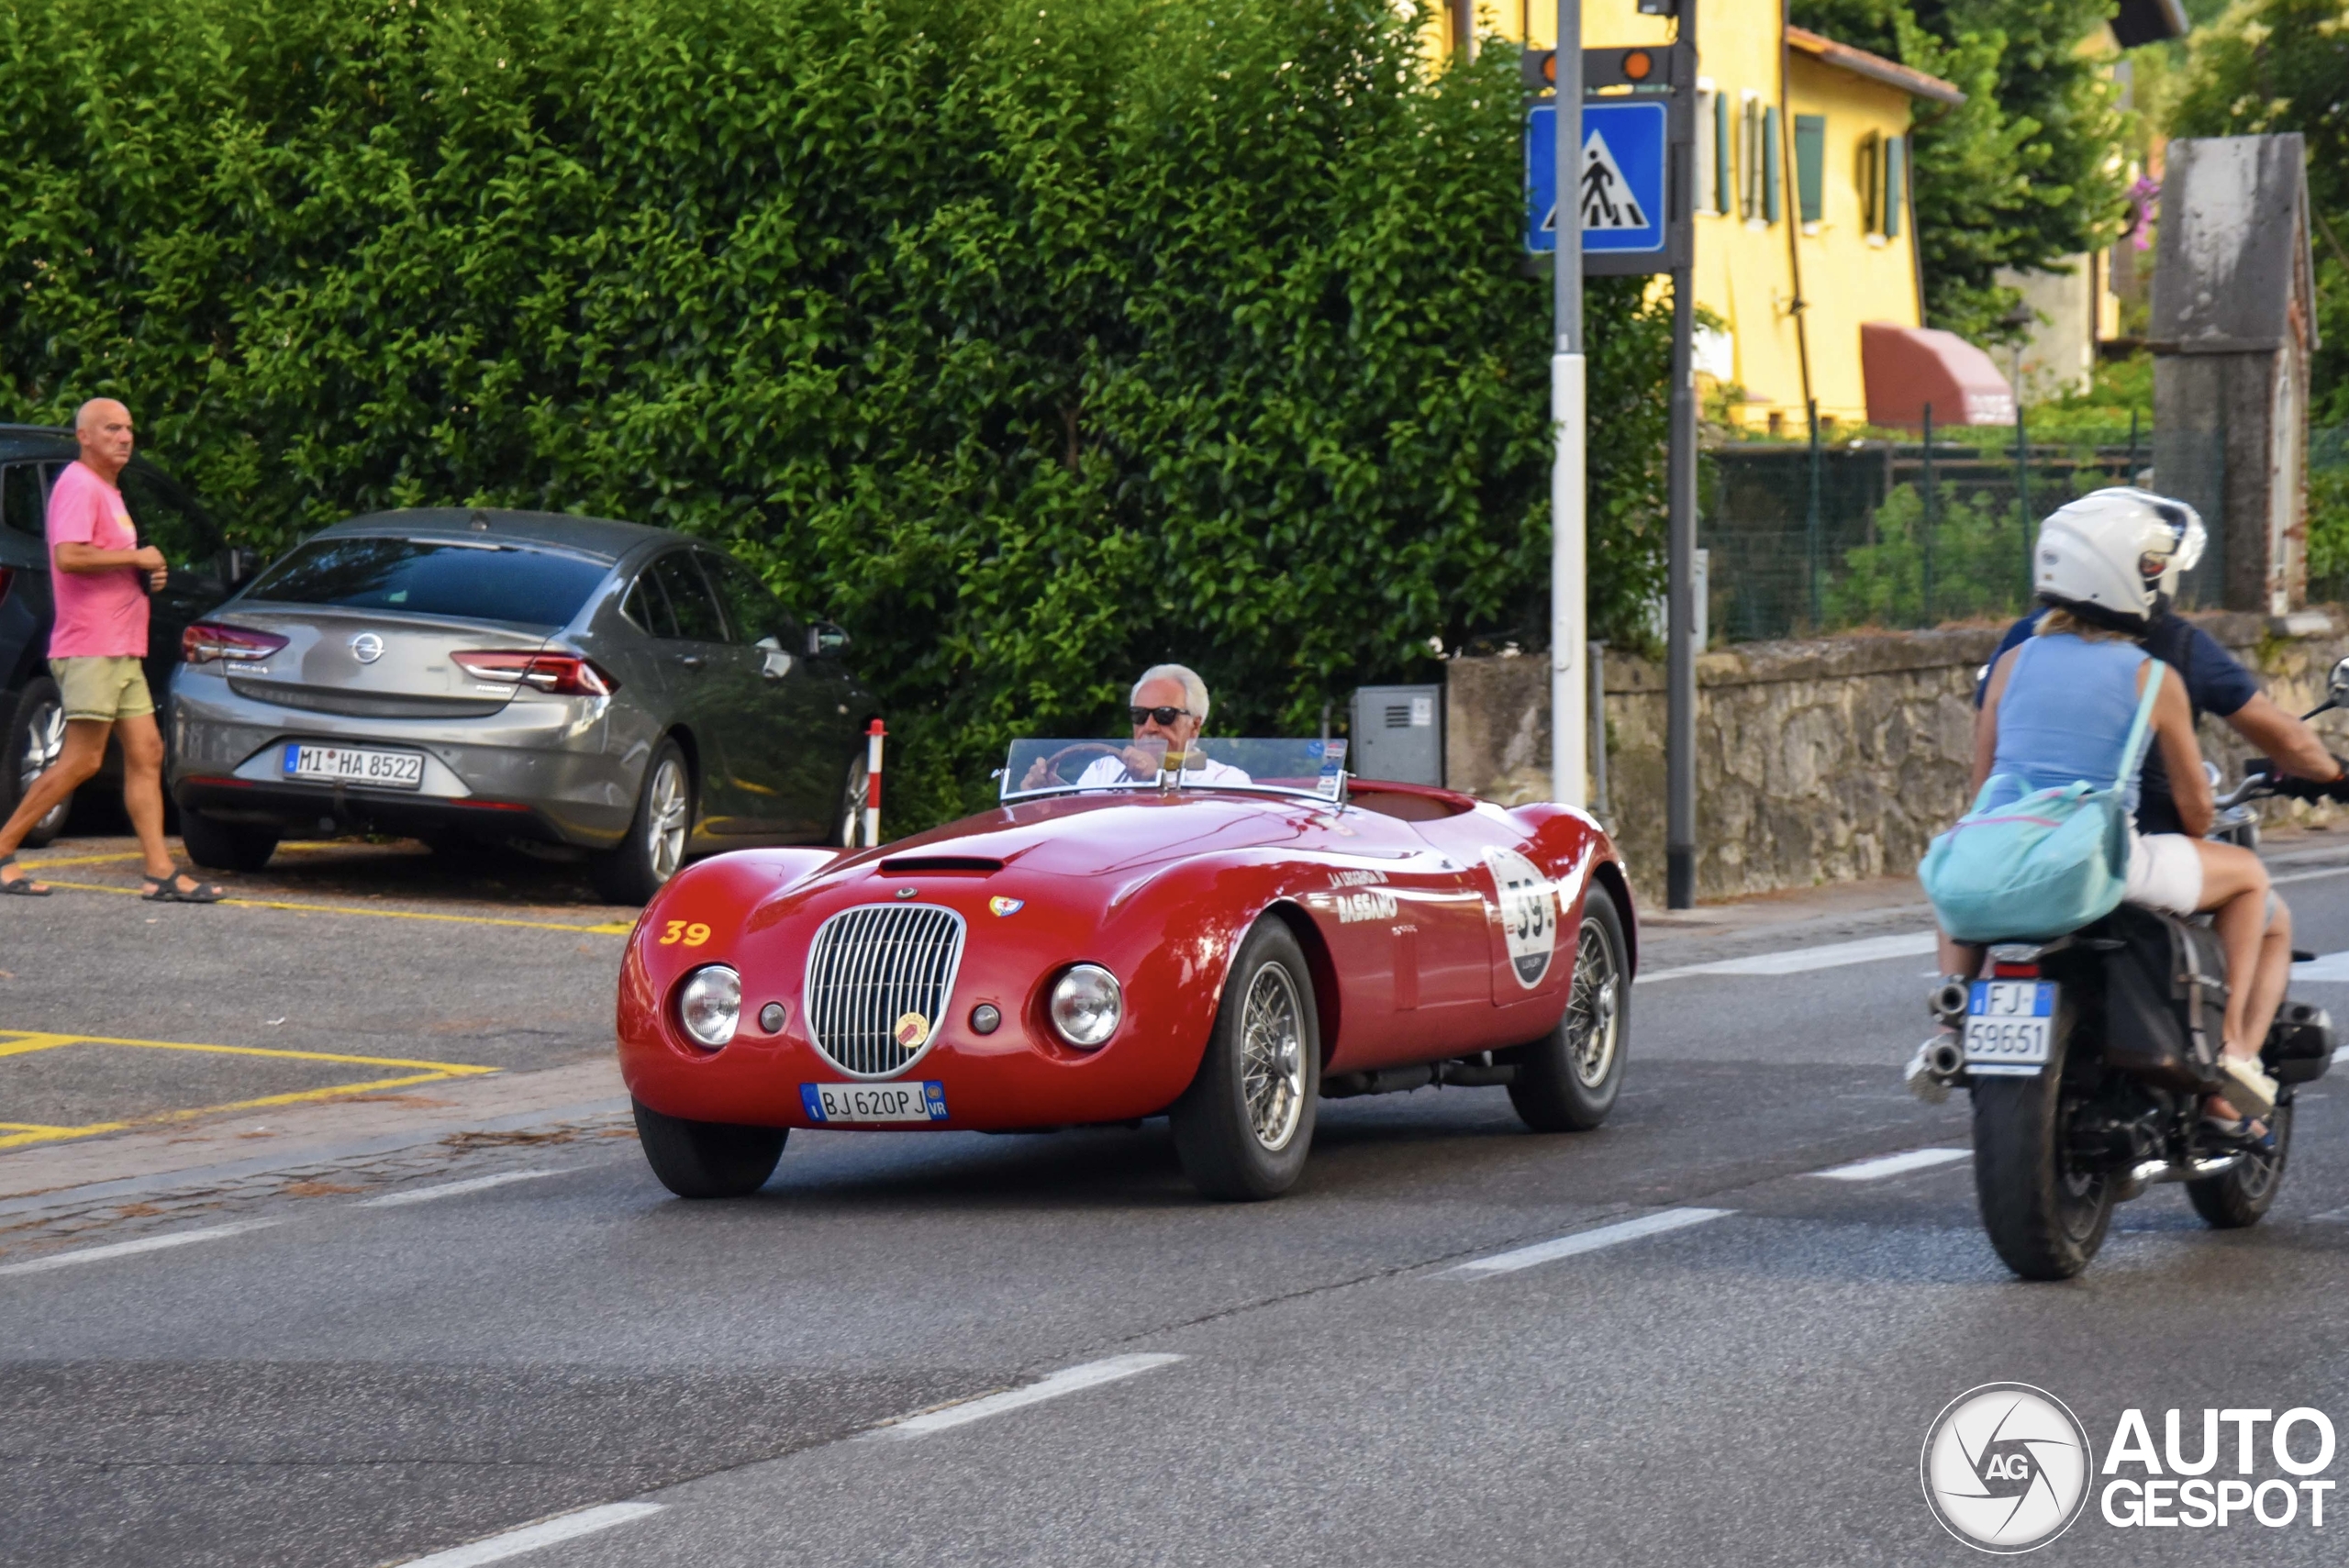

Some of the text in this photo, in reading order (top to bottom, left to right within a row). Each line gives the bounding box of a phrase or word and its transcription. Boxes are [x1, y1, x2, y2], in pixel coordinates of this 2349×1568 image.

[298, 751, 419, 780] MI HA 8522
[659, 919, 712, 947] 39
[1989, 985, 2021, 1014] FJ
[1967, 1023, 2043, 1055] 59651
[929, 1102, 947, 1116] VR
